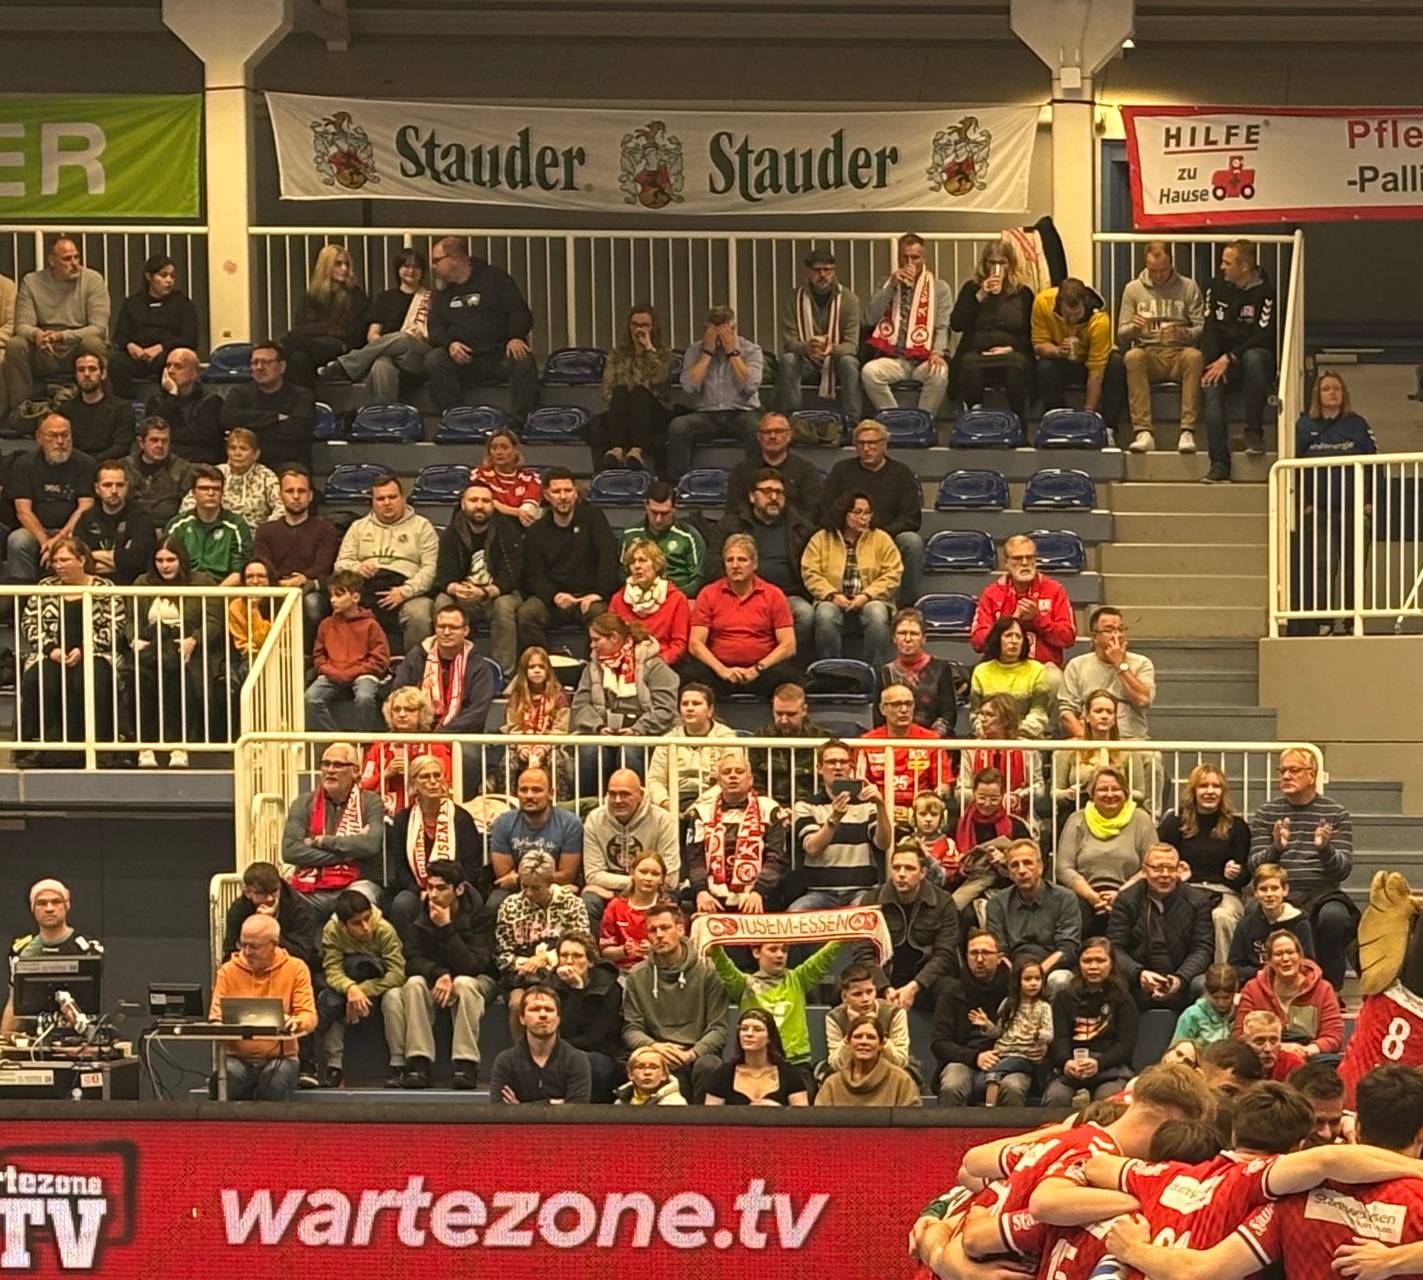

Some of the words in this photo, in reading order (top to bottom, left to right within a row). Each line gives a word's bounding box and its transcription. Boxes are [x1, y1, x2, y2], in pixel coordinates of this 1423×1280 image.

[395, 125, 586, 191] Stauder
[1164, 125, 1261, 148] HILFE
[709, 128, 899, 202] Stauder
[1177, 167, 1198, 181] zu
[1159, 188, 1209, 204] Hause
[1381, 1016, 1411, 1061] 8
[0, 1198, 107, 1269] TV
[221, 1175, 830, 1249] wartezone.tv
